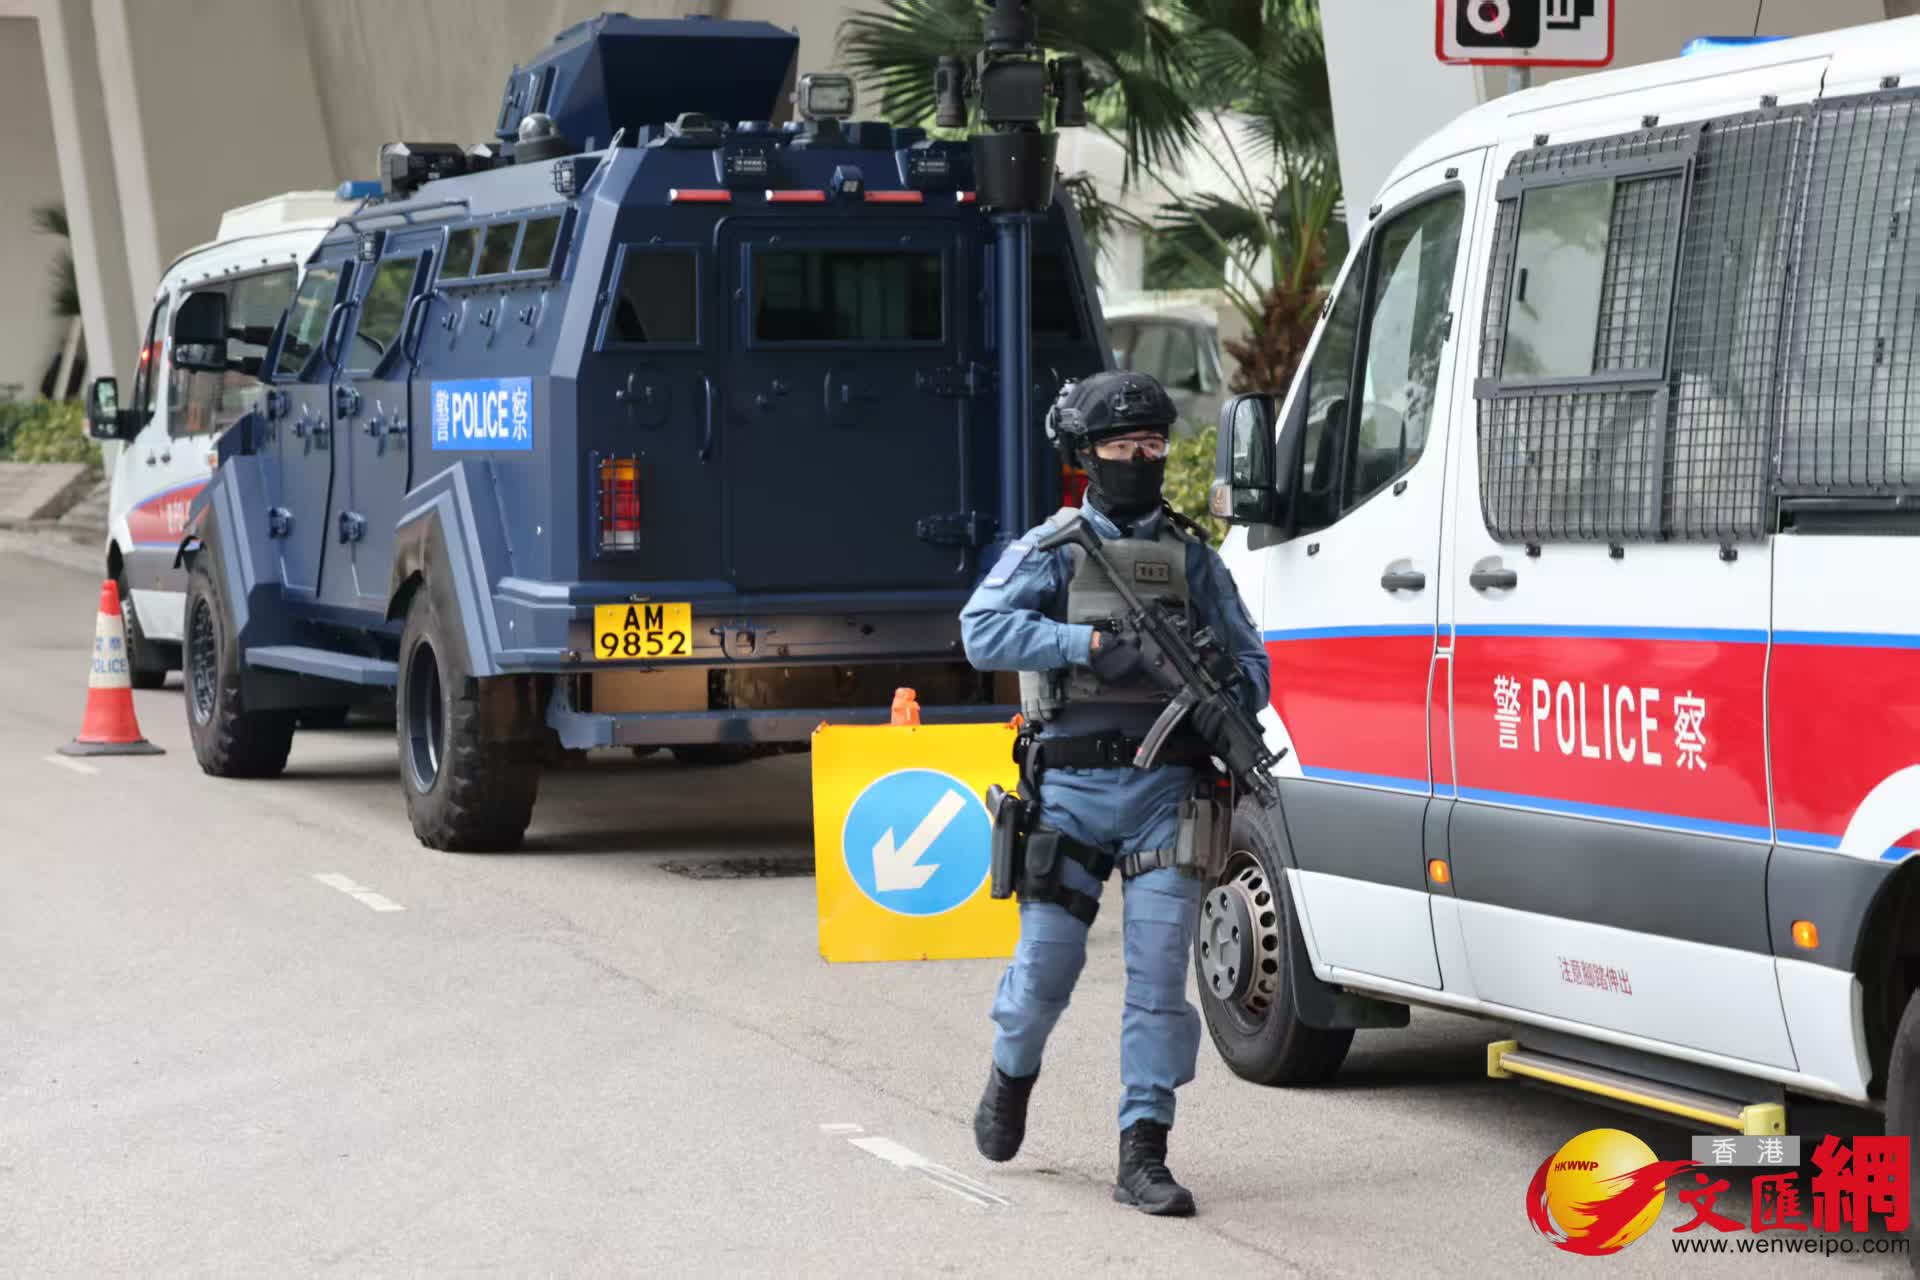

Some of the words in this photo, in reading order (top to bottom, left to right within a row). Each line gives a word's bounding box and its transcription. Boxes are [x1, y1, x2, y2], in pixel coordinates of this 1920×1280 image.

[451, 391, 509, 439] POLICE
[512, 384, 528, 441] 察
[623, 605, 664, 631] AM
[601, 631, 686, 657] 9852
[1493, 674, 1521, 749] 警
[1531, 678, 1662, 766] POLICE
[1673, 690, 1708, 771] 察
